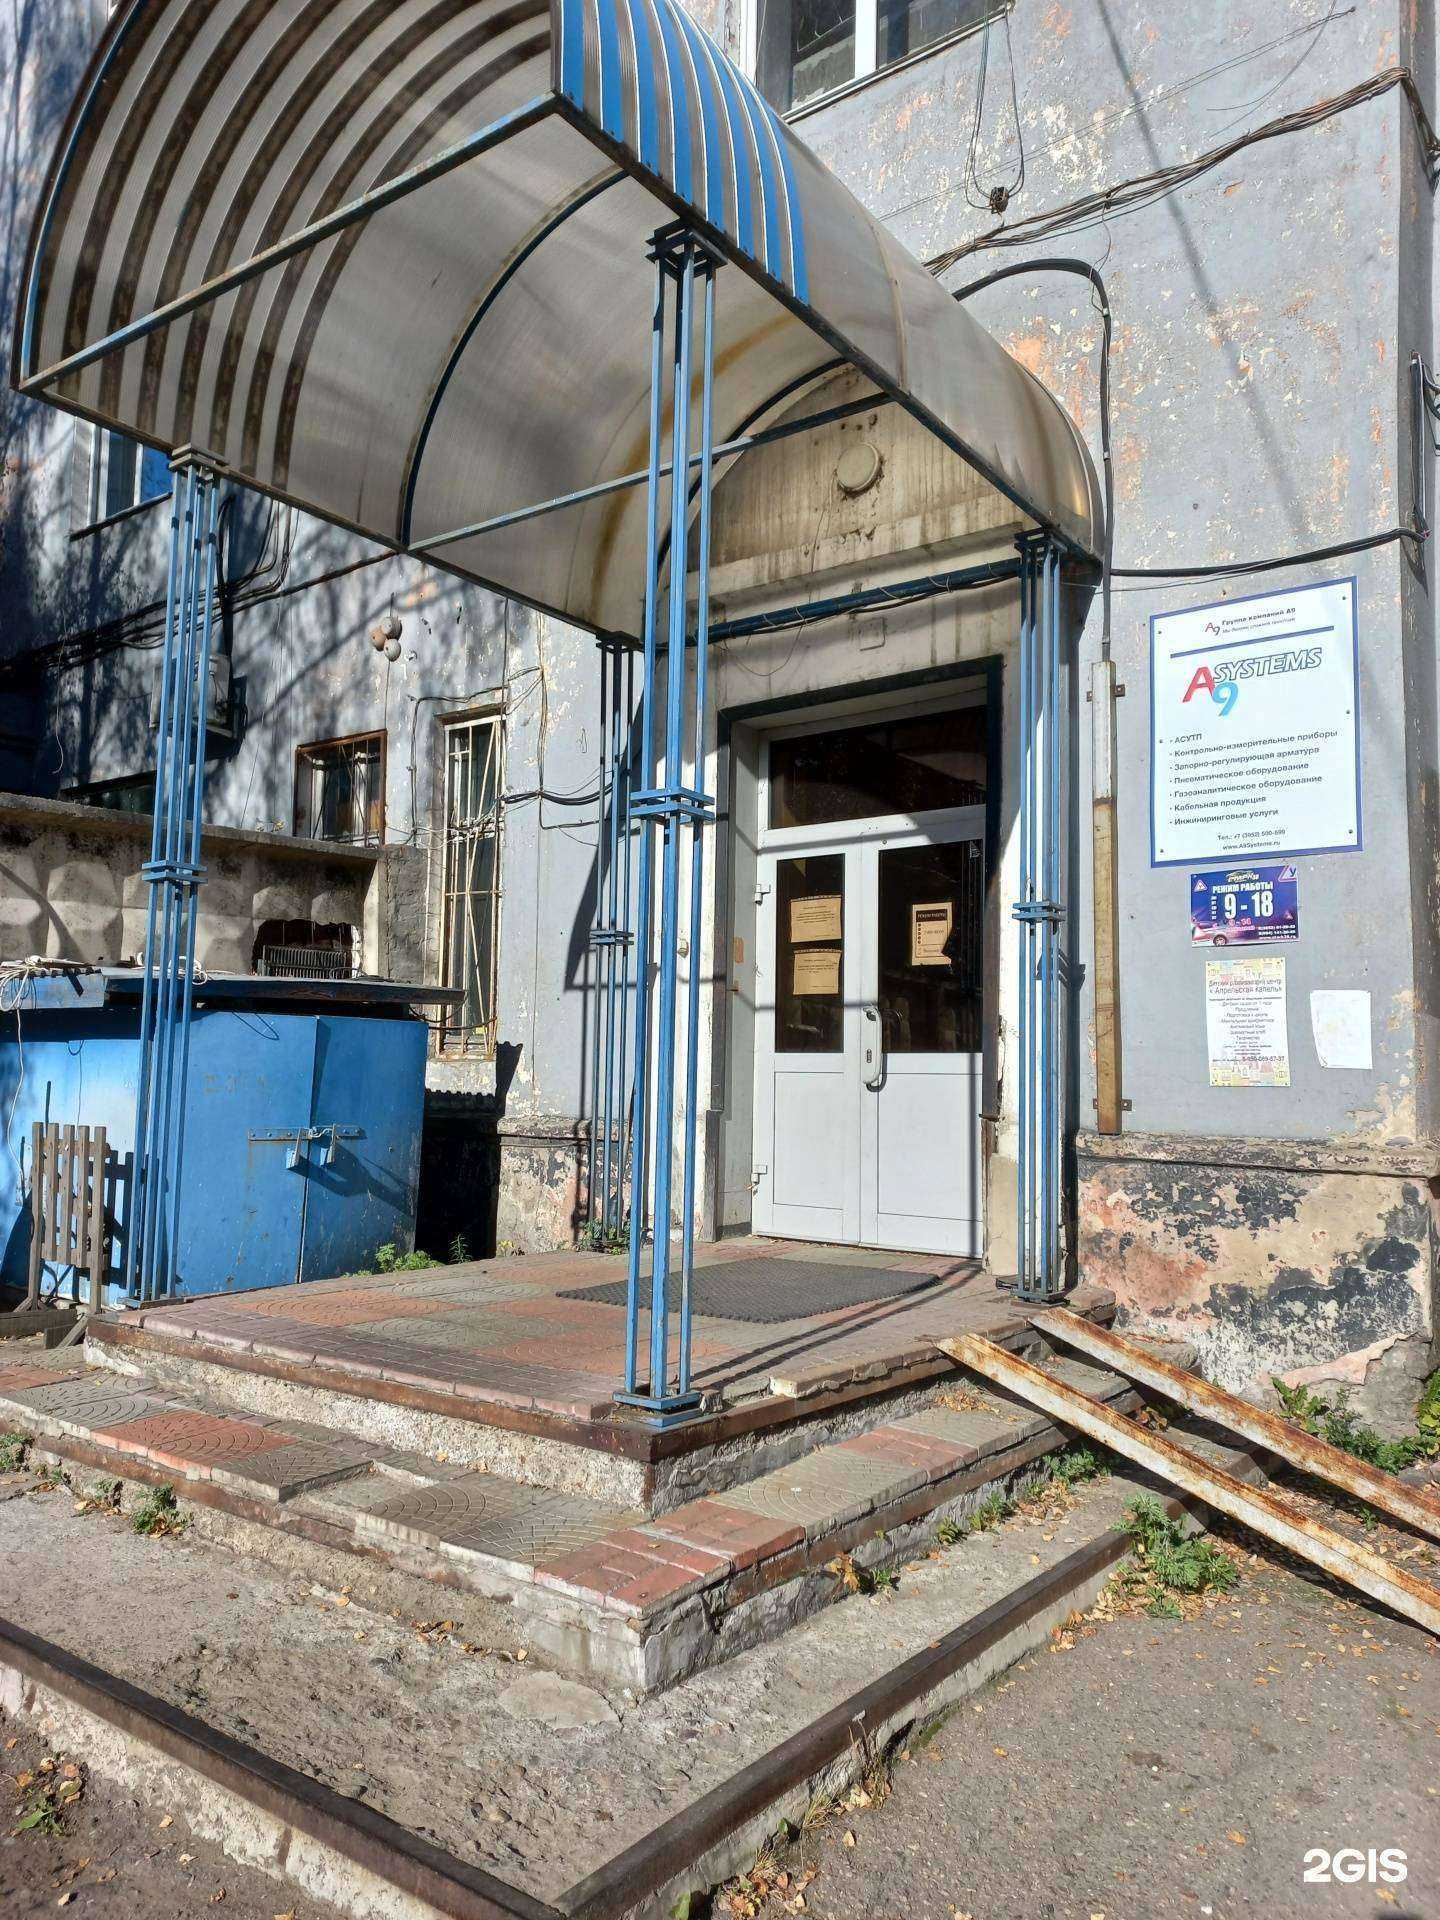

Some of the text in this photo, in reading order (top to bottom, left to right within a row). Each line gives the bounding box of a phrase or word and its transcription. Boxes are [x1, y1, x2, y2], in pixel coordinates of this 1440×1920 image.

[1213, 647, 1322, 684] SYSTEMS
[1174, 733, 1202, 744] АСУТП
[1174, 730, 1338, 757] Контрольно-измерительные приборы
[1174, 747, 1319, 771] Запорно-регулирующая арматура
[1245, 763, 1309, 776] оборудование
[1174, 776, 1322, 798] Газоаналитическое оборудование
[1174, 796, 1266, 812] Кабельная продукция
[1174, 809, 1279, 825] Инжиниринговые услуги
[1212, 881, 1274, 894] РЕЖИМ РАБОТЫ
[1224, 893, 1237, 919] 9
[1251, 890, 1274, 918] 18
